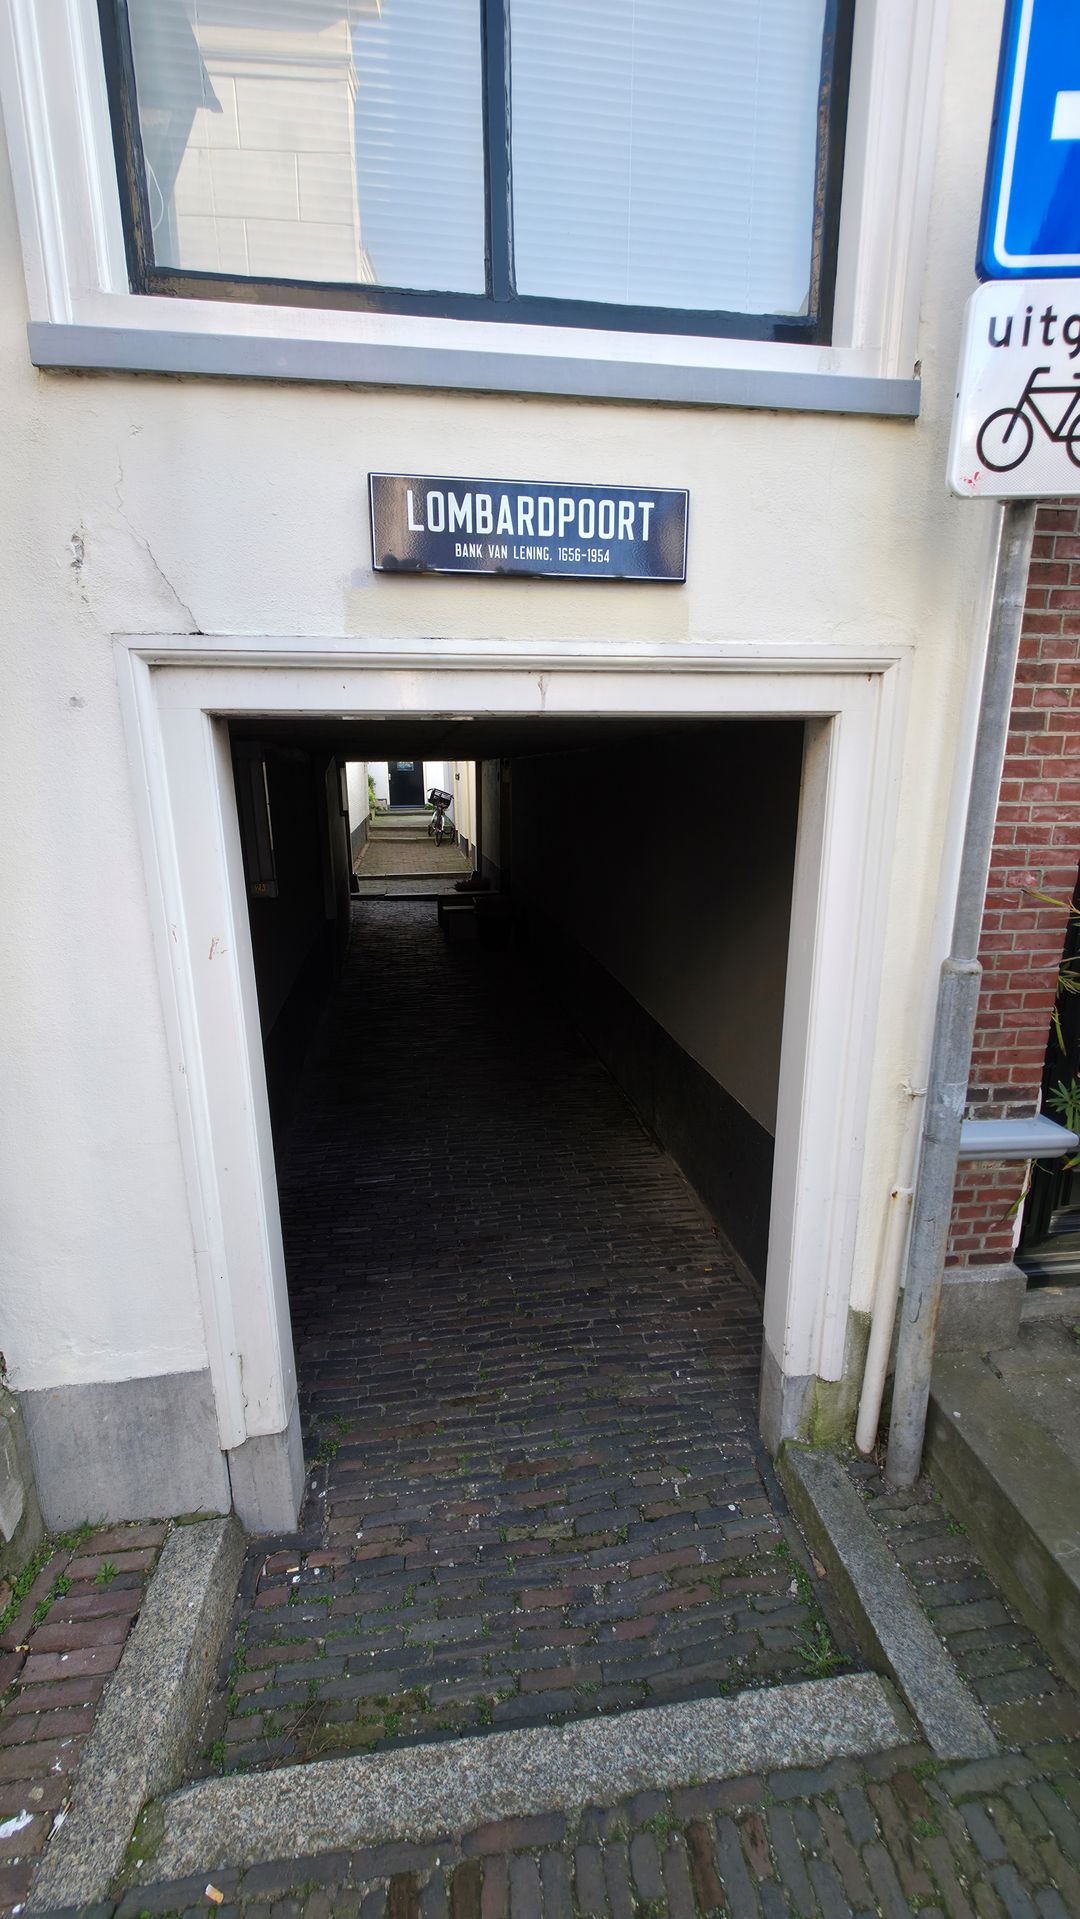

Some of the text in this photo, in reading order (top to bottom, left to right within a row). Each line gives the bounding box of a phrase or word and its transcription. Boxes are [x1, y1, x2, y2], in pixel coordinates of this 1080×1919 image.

[406, 489, 655, 541] LOMBARDPOORT
[455, 543, 483, 559] BANK
[488, 544, 508, 560] VAN
[558, 547, 610, 564] 1656-1954
